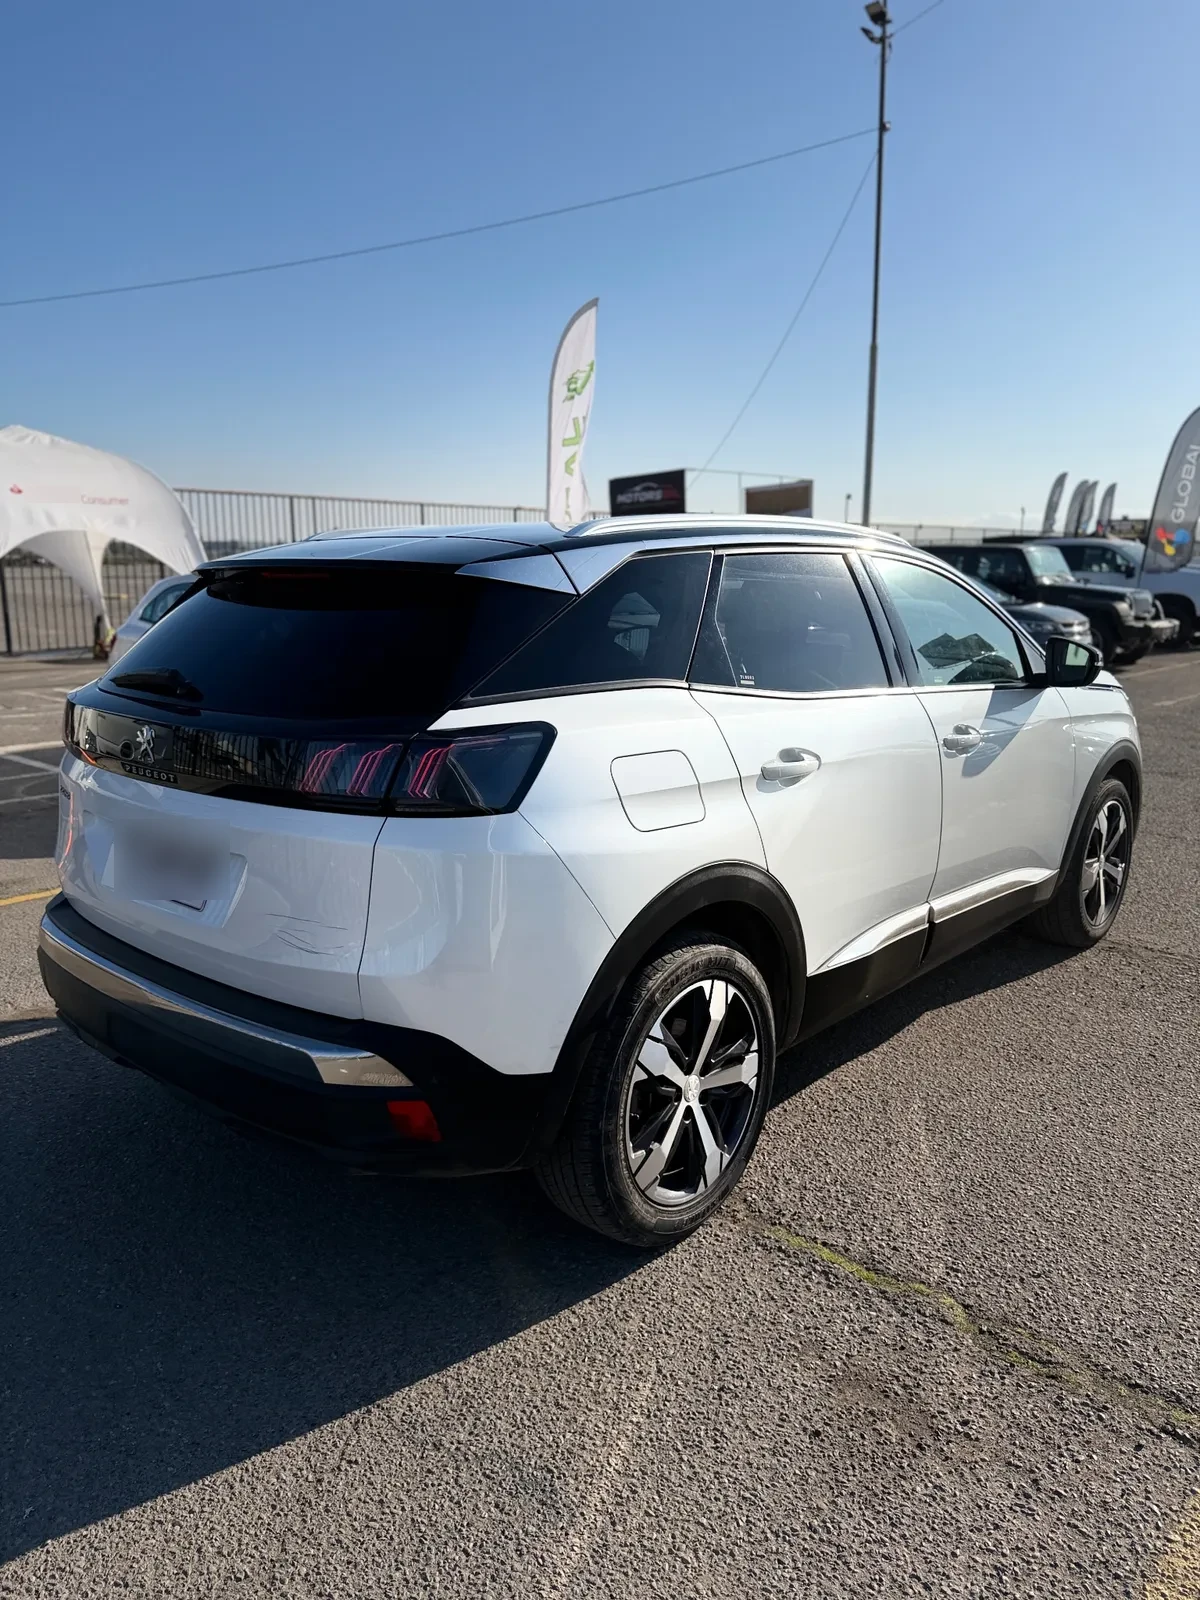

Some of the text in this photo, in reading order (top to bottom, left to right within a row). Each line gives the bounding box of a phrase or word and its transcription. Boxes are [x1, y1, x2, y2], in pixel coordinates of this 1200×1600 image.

[80, 493, 129, 505] Consumer
[616, 489, 663, 504] MOTORS
[124, 764, 175, 782] PEUGEOT
